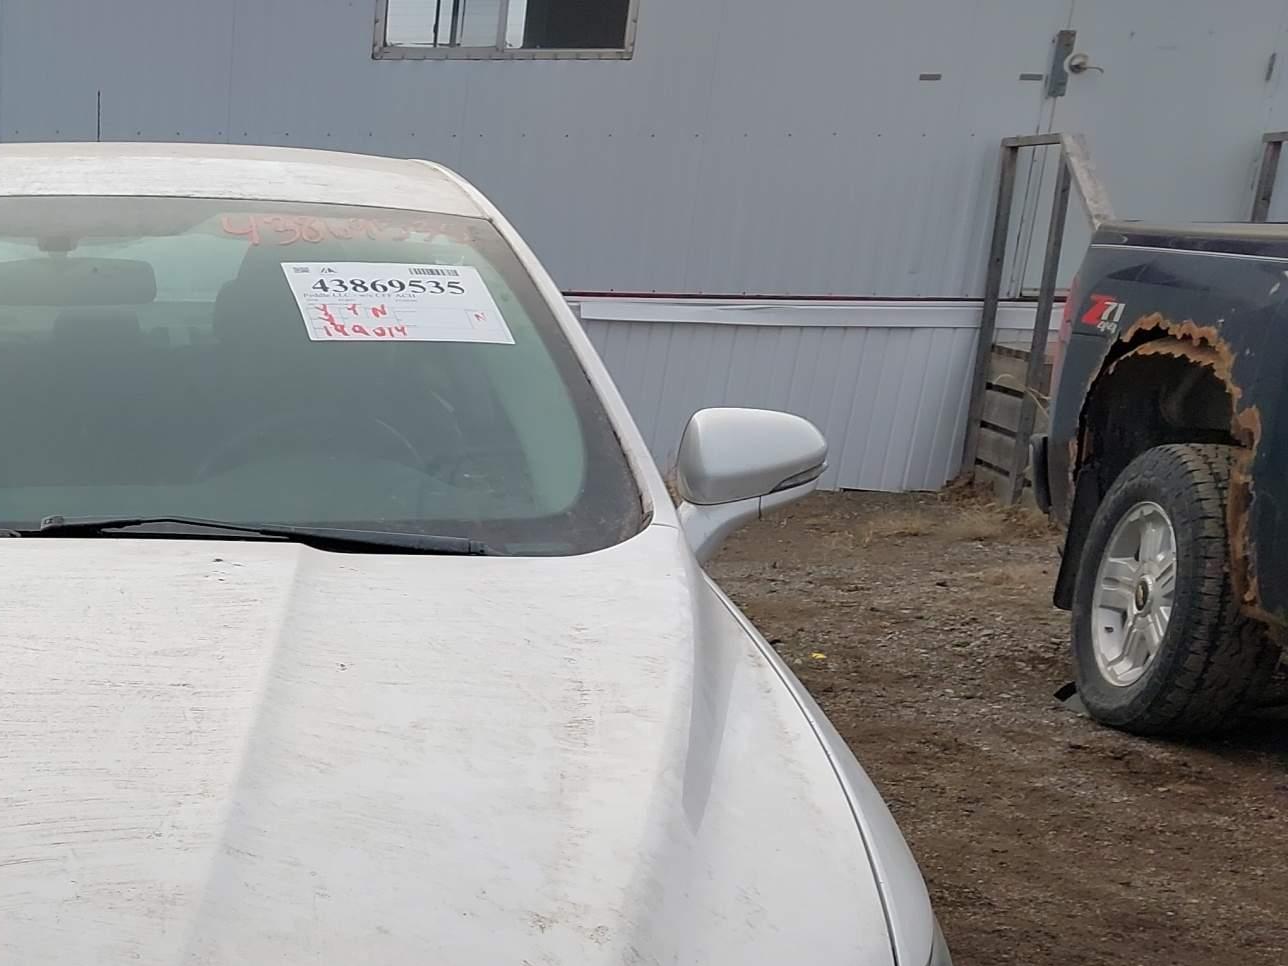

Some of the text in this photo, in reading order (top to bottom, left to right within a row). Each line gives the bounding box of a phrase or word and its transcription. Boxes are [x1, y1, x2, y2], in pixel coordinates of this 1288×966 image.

[312, 278, 465, 295] 43869535
[371, 304, 387, 318] N
[1081, 294, 1127, 326] Z71
